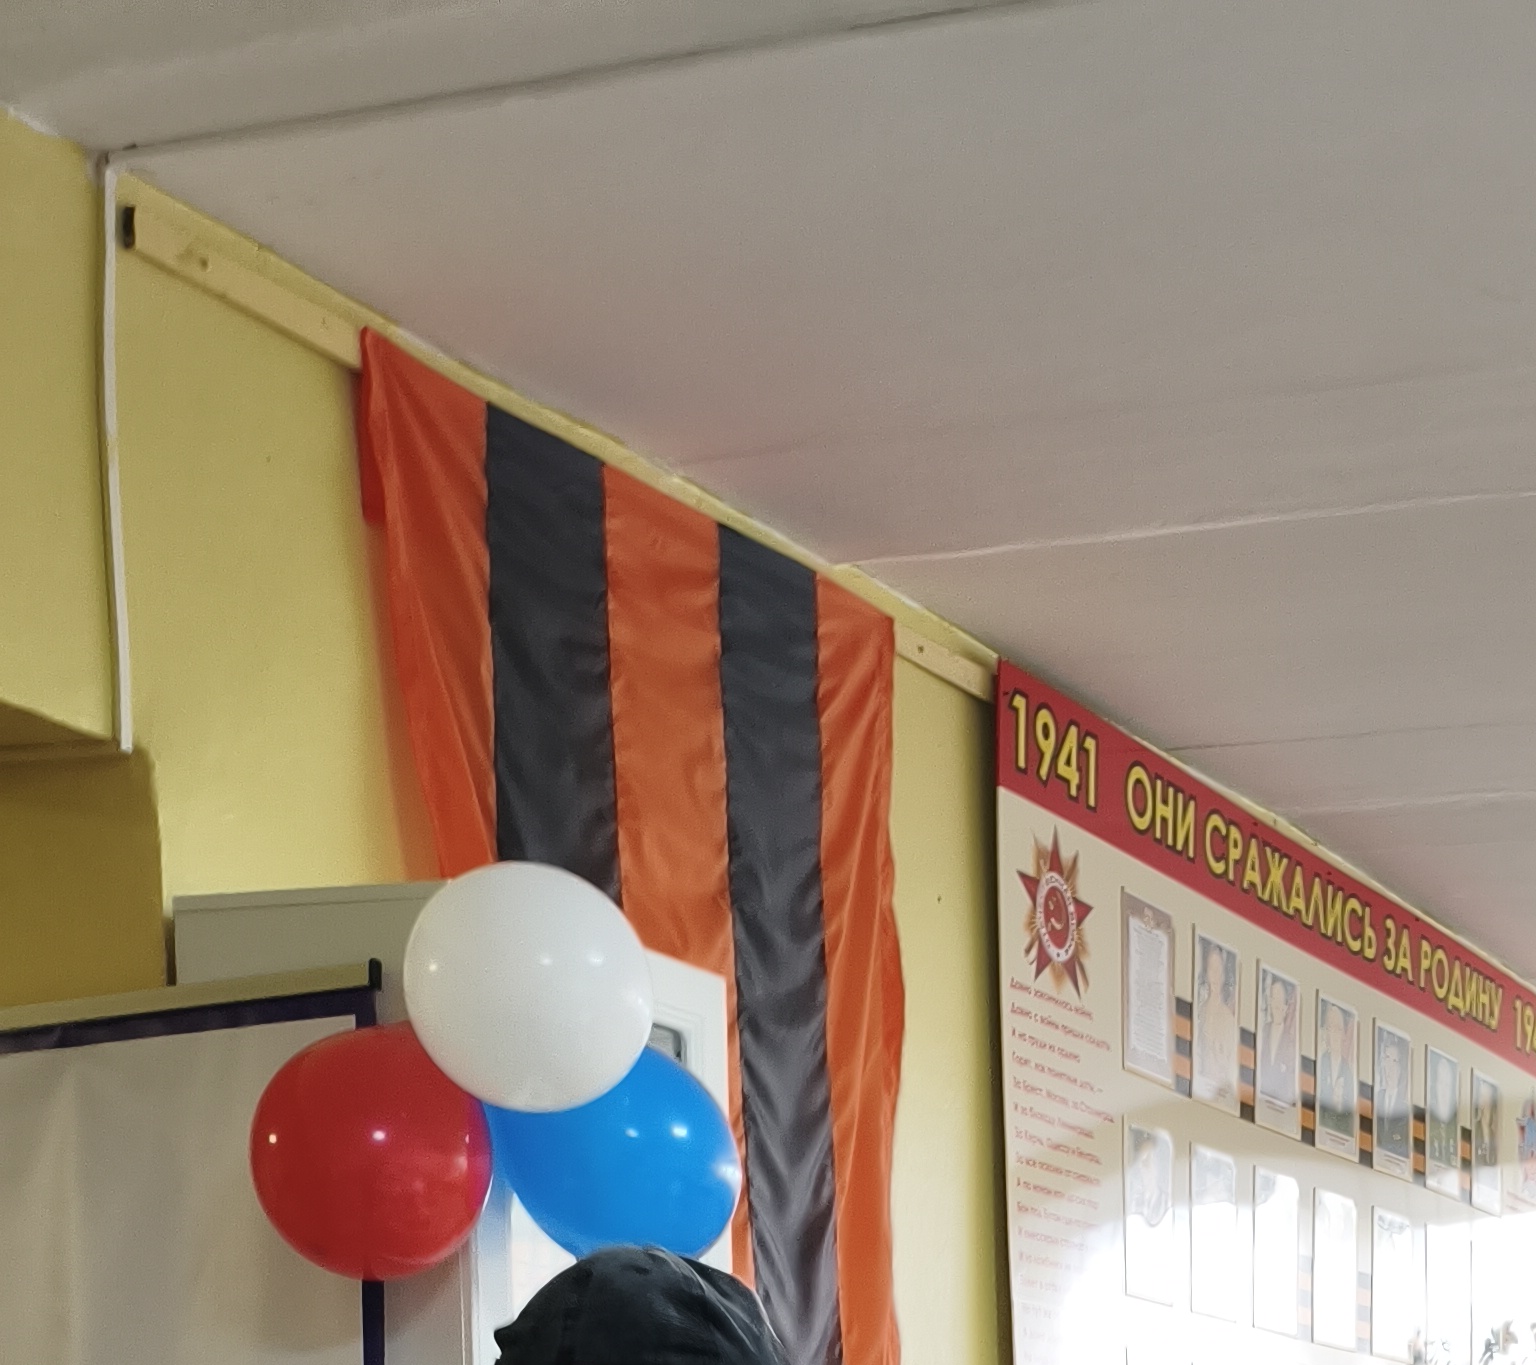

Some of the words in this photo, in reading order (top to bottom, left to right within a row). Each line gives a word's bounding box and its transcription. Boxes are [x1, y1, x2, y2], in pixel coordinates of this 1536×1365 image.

[1010, 690, 1097, 811] 1941
[1125, 762, 1196, 861] ОНИ
[1205, 812, 1378, 960] СРАЖАЛИСЬ
[1383, 917, 1414, 983] ЗА
[1419, 939, 1503, 1031] РОДИНУ
